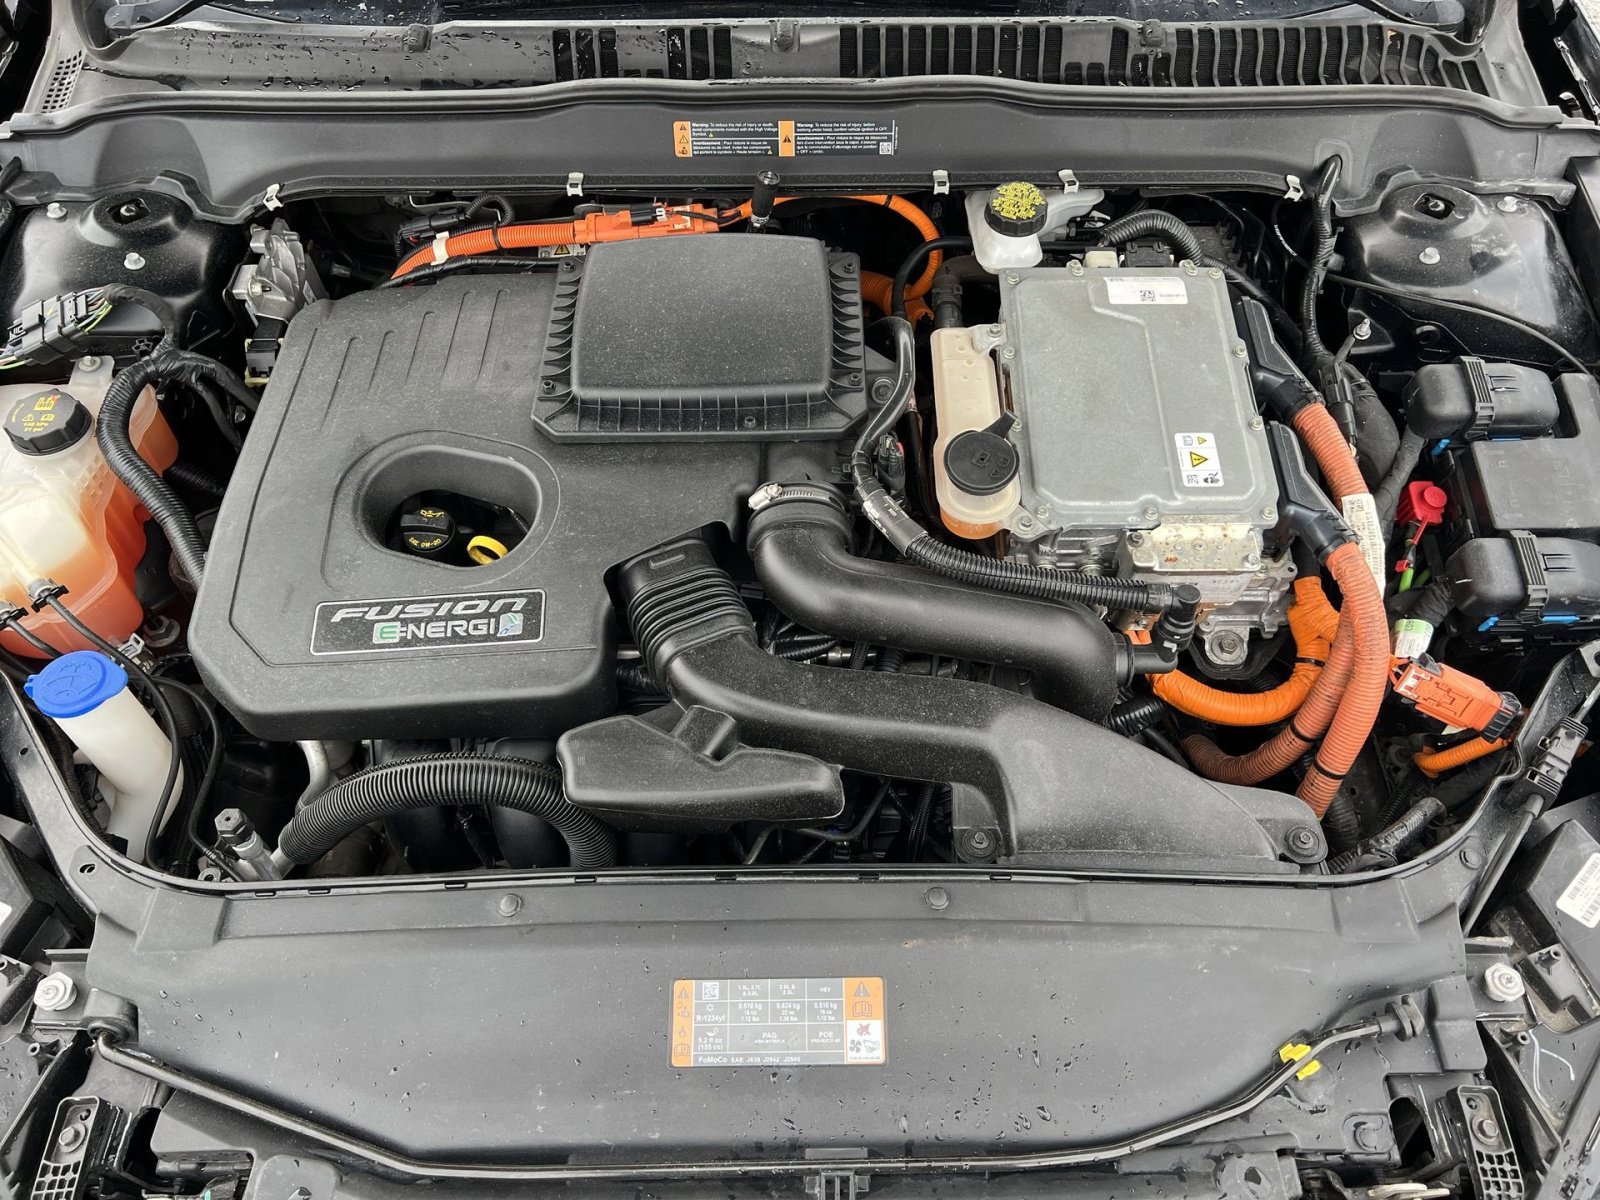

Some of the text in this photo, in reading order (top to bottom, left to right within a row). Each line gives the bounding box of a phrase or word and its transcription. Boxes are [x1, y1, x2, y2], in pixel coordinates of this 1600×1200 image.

[409, 537, 441, 549] SAE 0W-20
[330, 597, 528, 623] FUSION
[698, 1056, 728, 1064] FoMoCo
